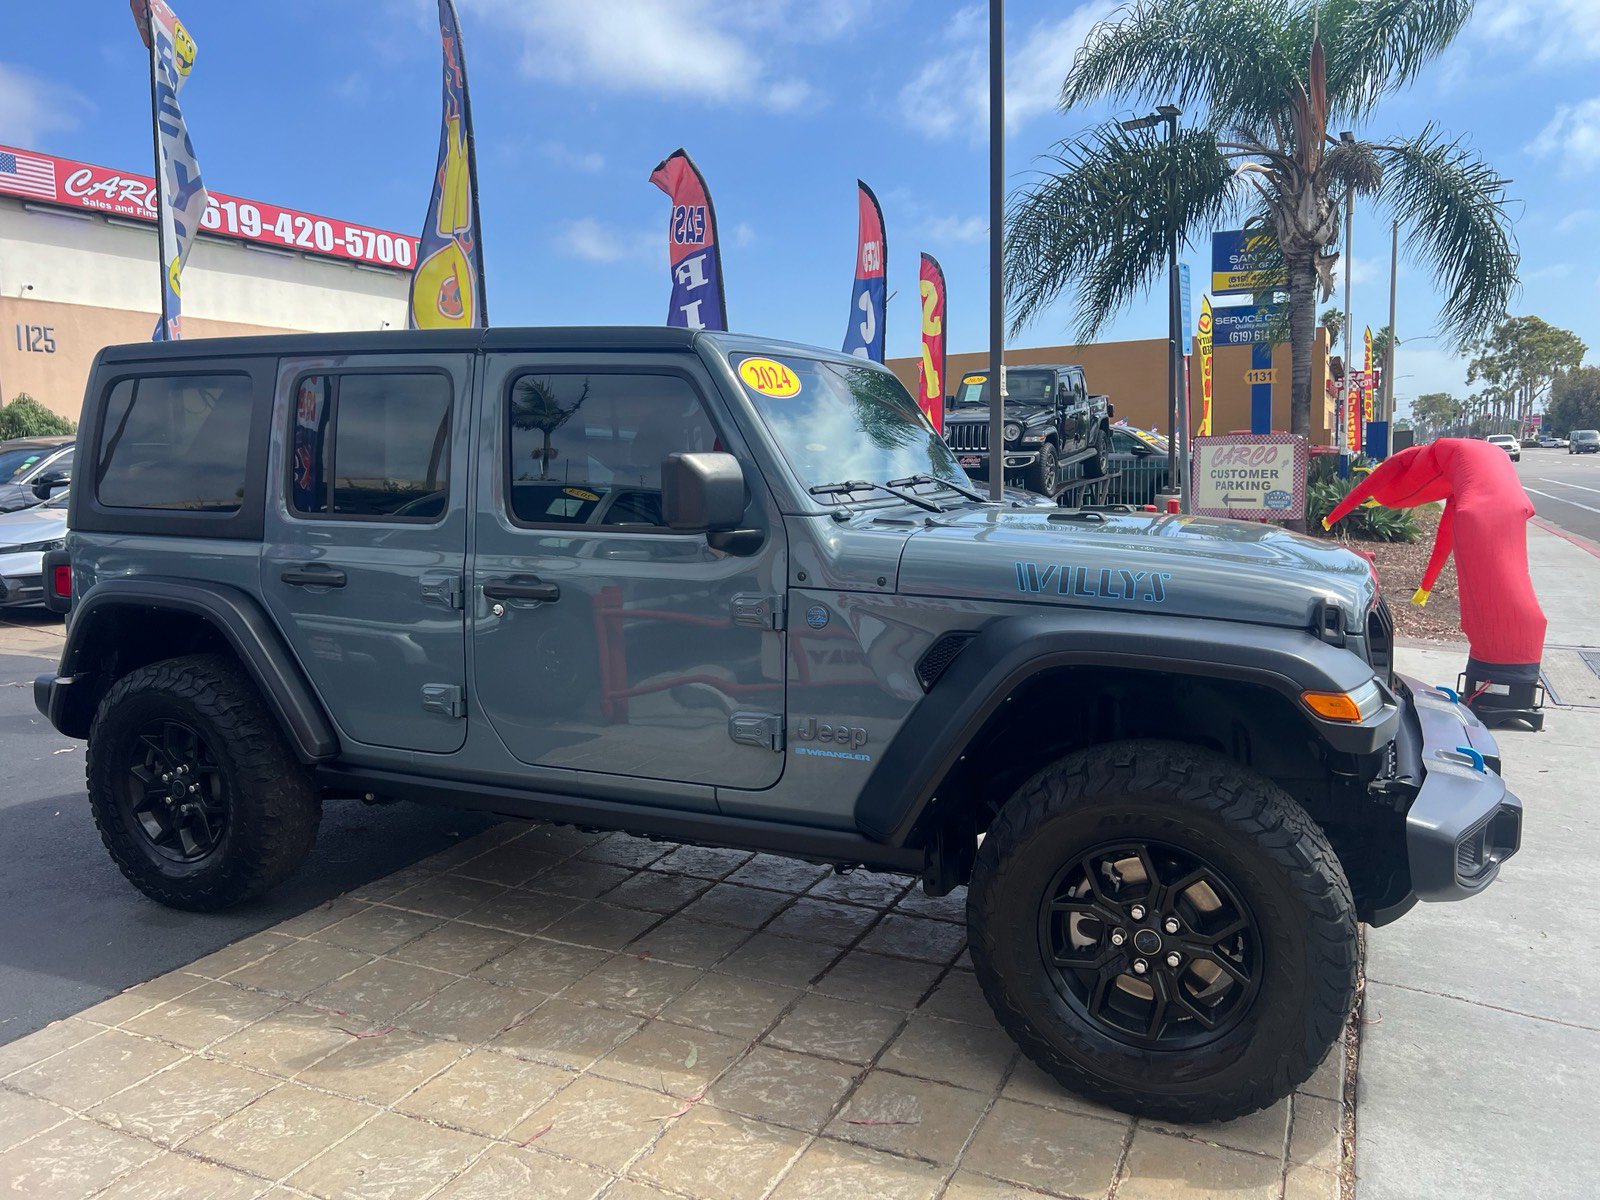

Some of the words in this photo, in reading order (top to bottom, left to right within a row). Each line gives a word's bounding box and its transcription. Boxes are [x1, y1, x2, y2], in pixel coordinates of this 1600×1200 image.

[82, 196, 111, 210] Sales
[115, 203, 134, 213] and
[137, 207, 158, 218] Fina
[201, 196, 411, 267] 619-420-5700
[1215, 314, 1263, 325] SERVICE
[16, 324, 55, 353] 1125
[1229, 331, 1252, 343] (619)
[750, 366, 791, 389] 2024
[1248, 371, 1272, 381] 1131
[1211, 446, 1277, 467] CARCO
[1210, 469, 1279, 479] CUSTOMER
[1215, 481, 1271, 490] PARKING
[1015, 562, 1170, 602] WILLYS
[798, 717, 868, 750] Jeep
